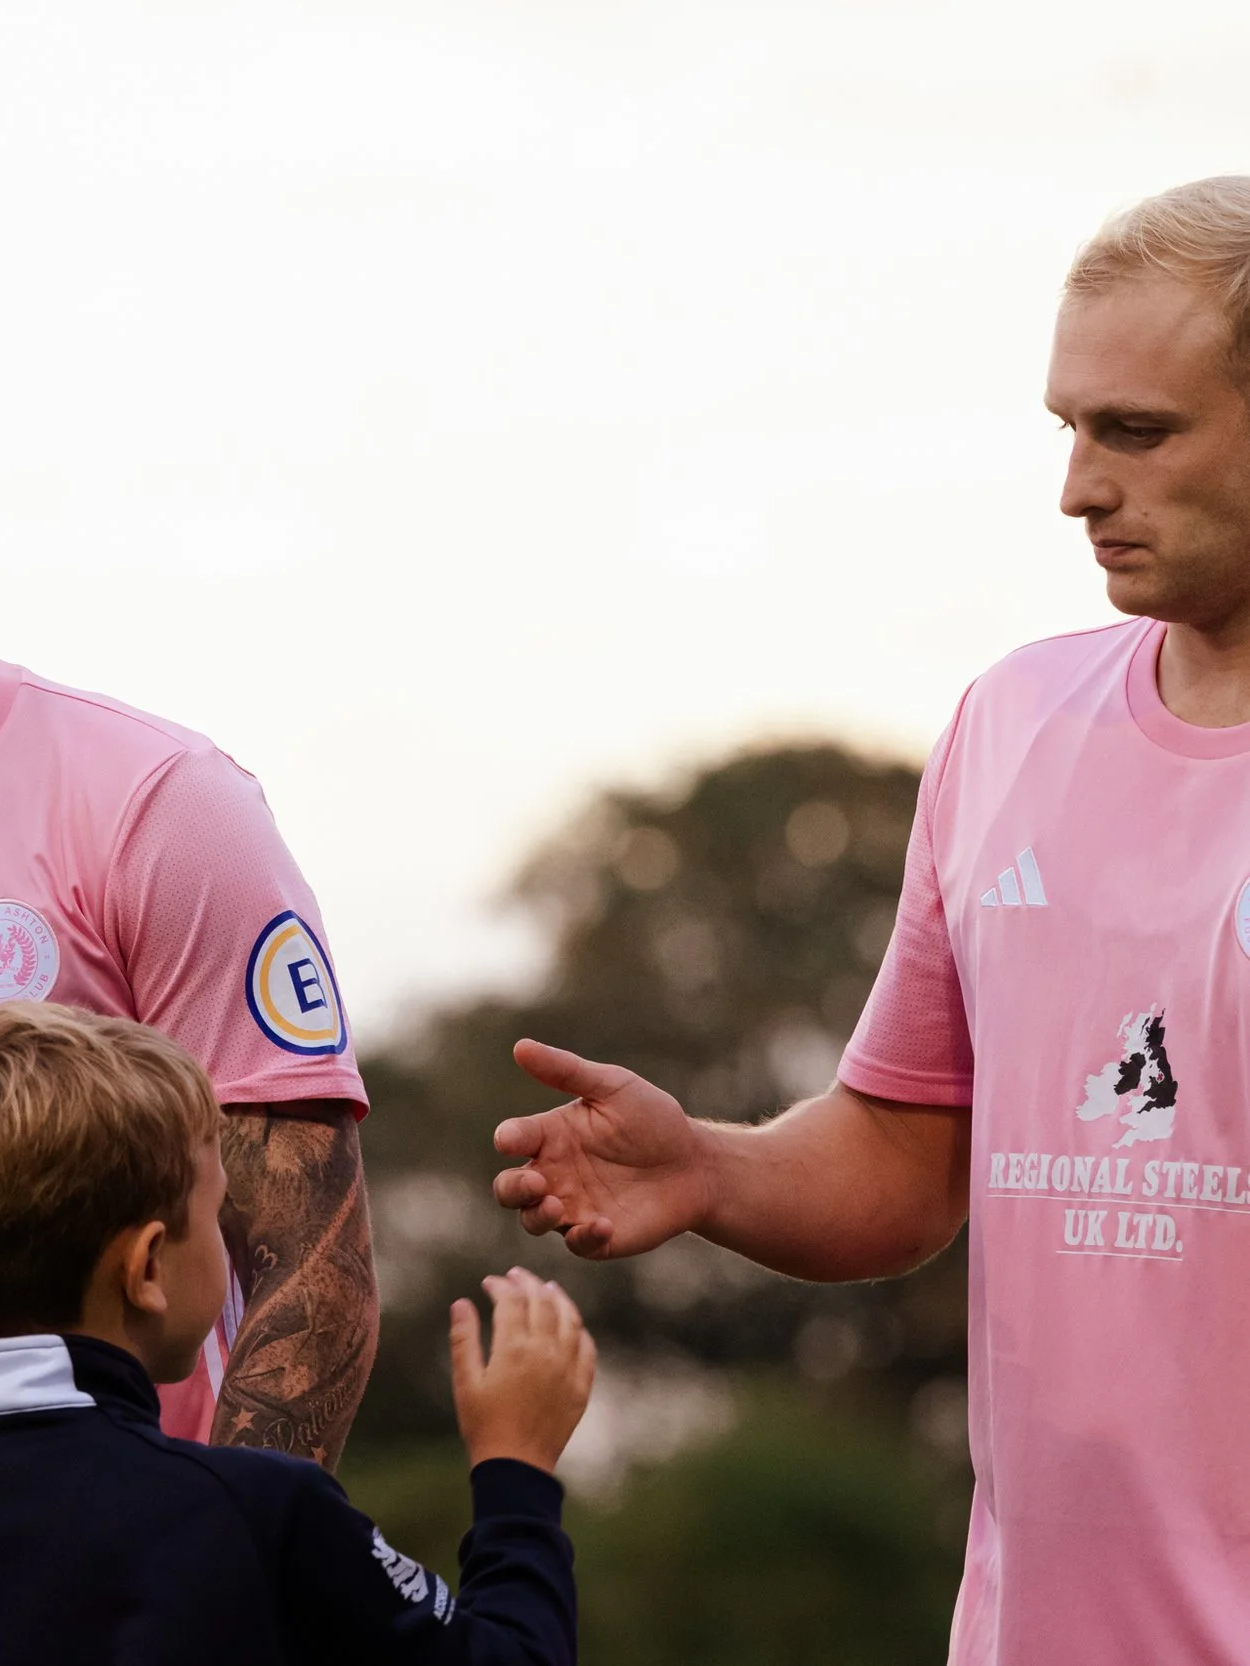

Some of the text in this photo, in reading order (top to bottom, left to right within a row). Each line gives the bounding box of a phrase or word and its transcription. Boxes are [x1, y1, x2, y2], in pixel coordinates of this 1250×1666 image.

[4, 907, 49, 944] ASHTON
[29, 974, 49, 998] LUB
[988, 1152, 1250, 1205] REGIONAL STEEL
[1064, 1209, 1183, 1253] UK LTD.
